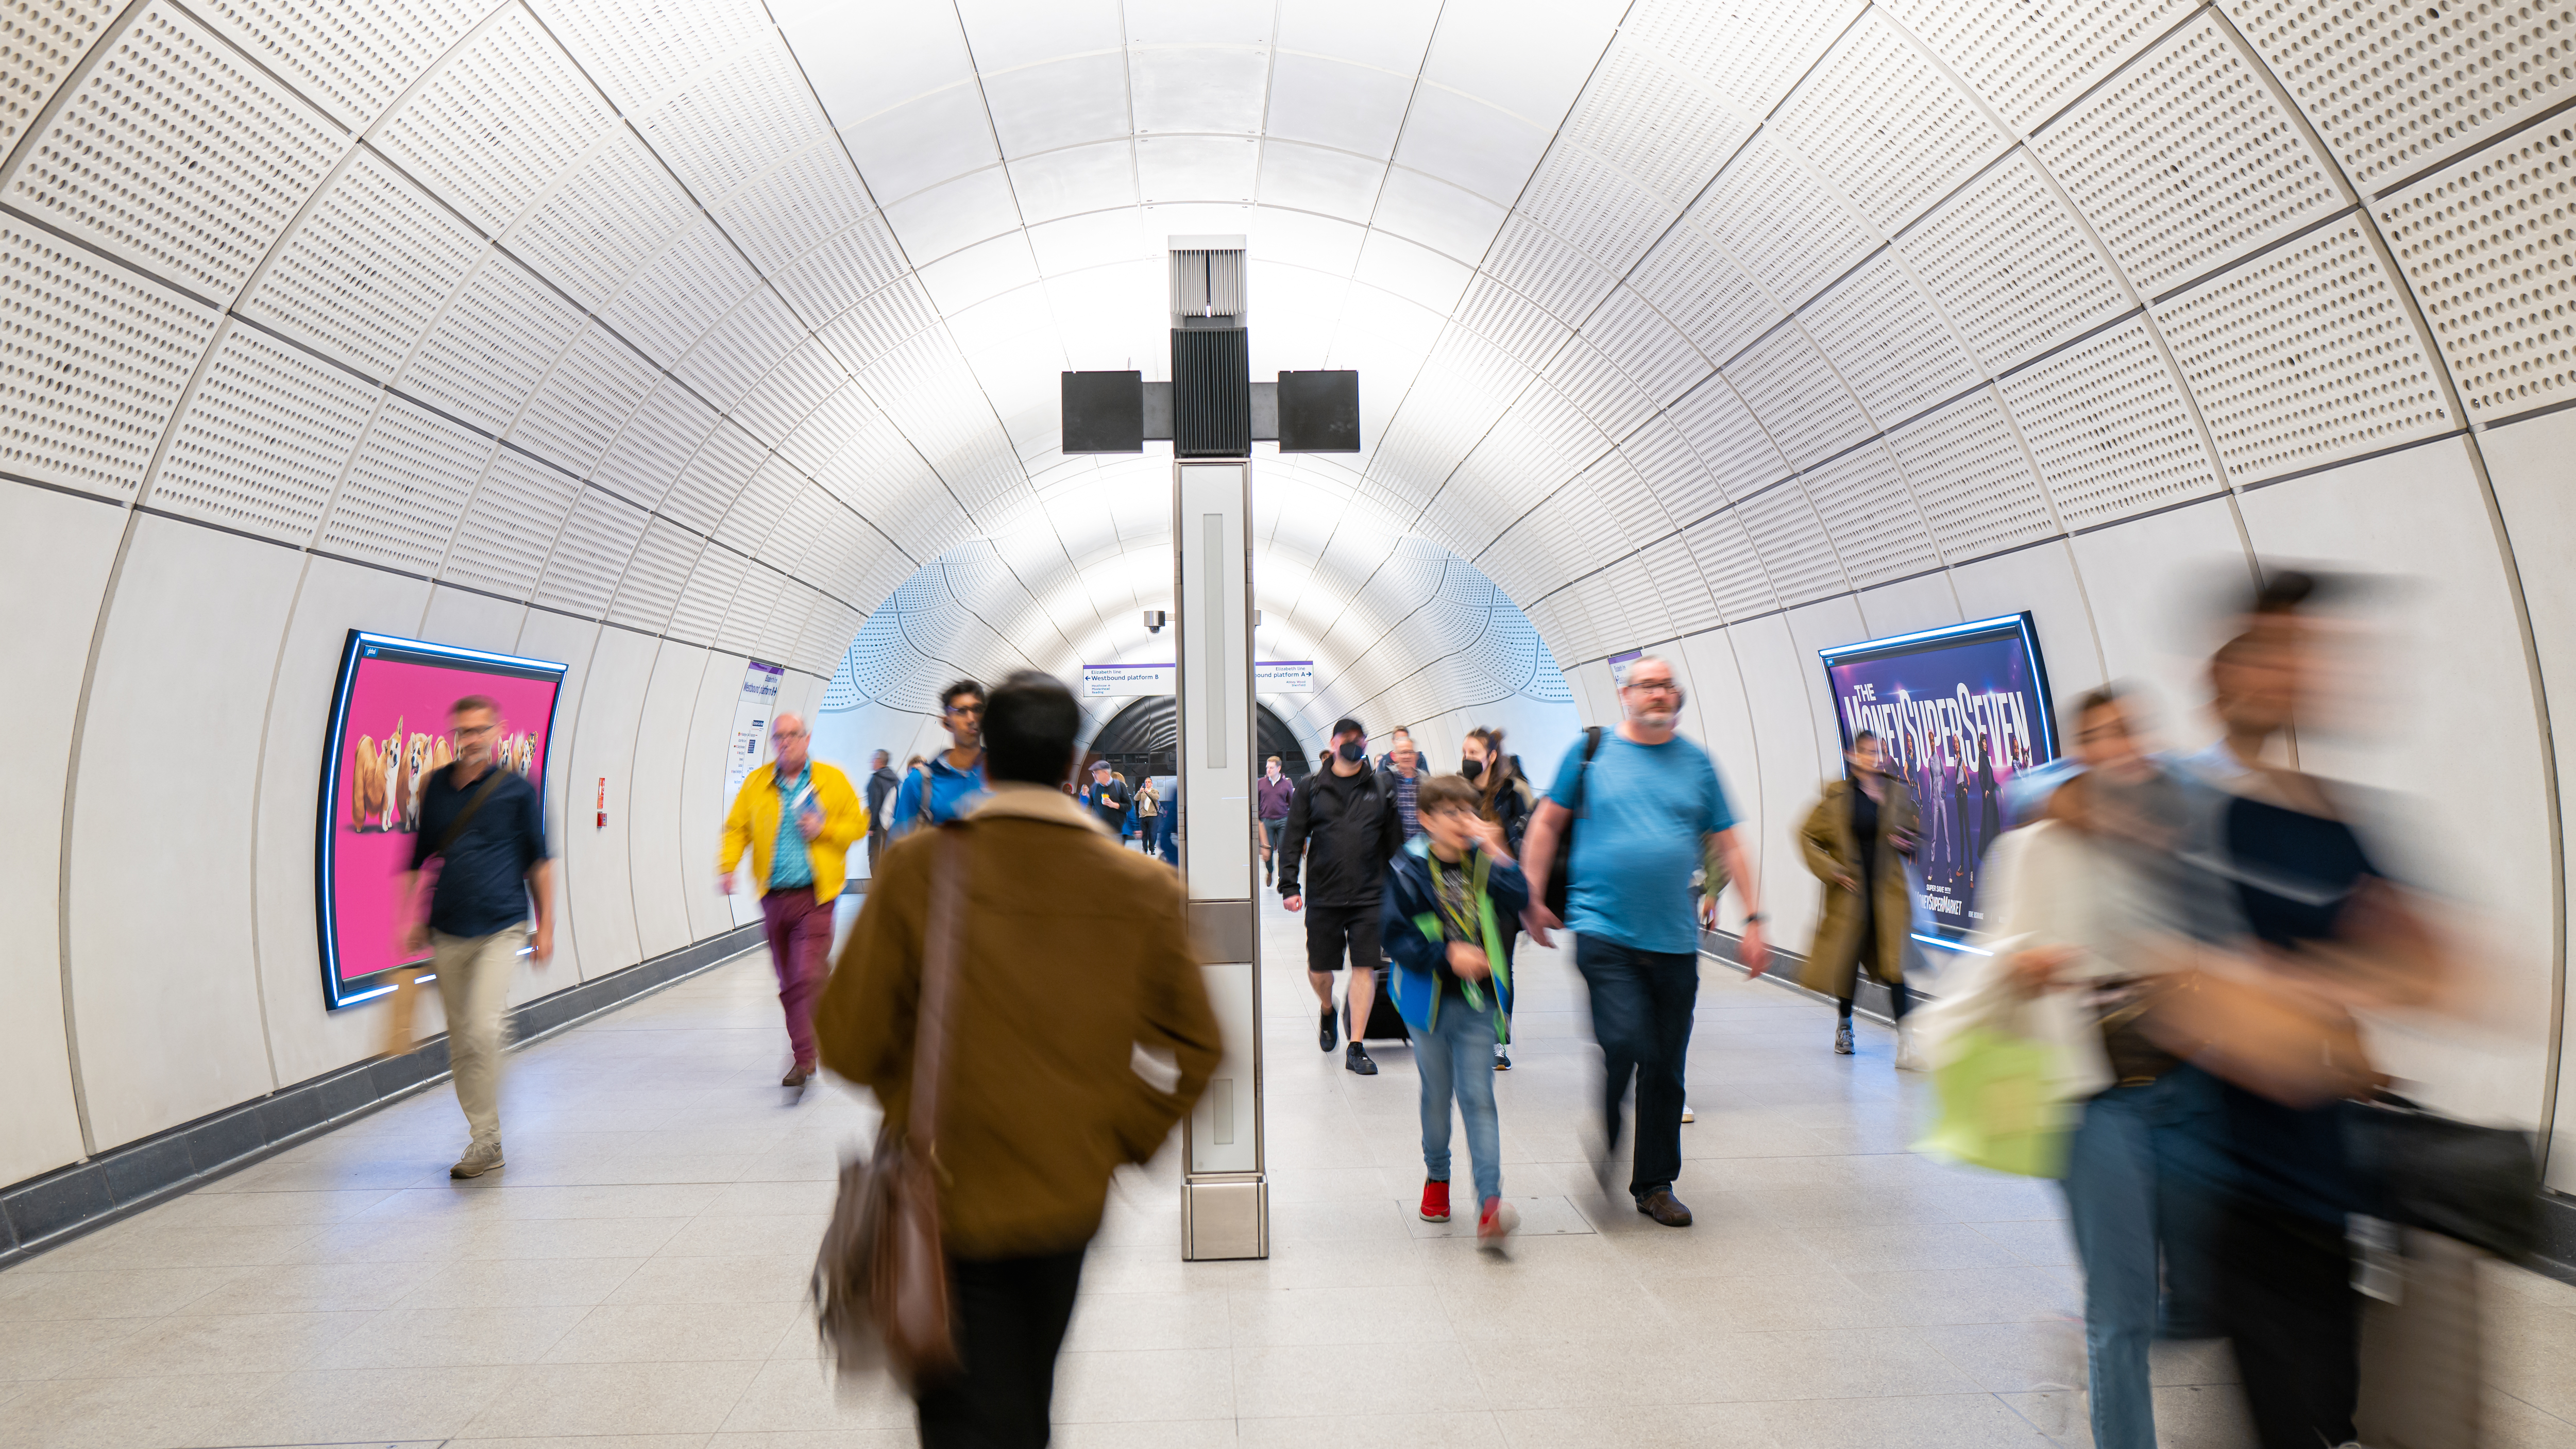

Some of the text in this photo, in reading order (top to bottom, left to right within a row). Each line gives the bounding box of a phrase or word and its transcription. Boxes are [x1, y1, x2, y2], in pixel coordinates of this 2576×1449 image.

[743, 681, 761, 694] Westbound
[758, 685, 772, 696] platform
[1854, 683, 1876, 702] THE
